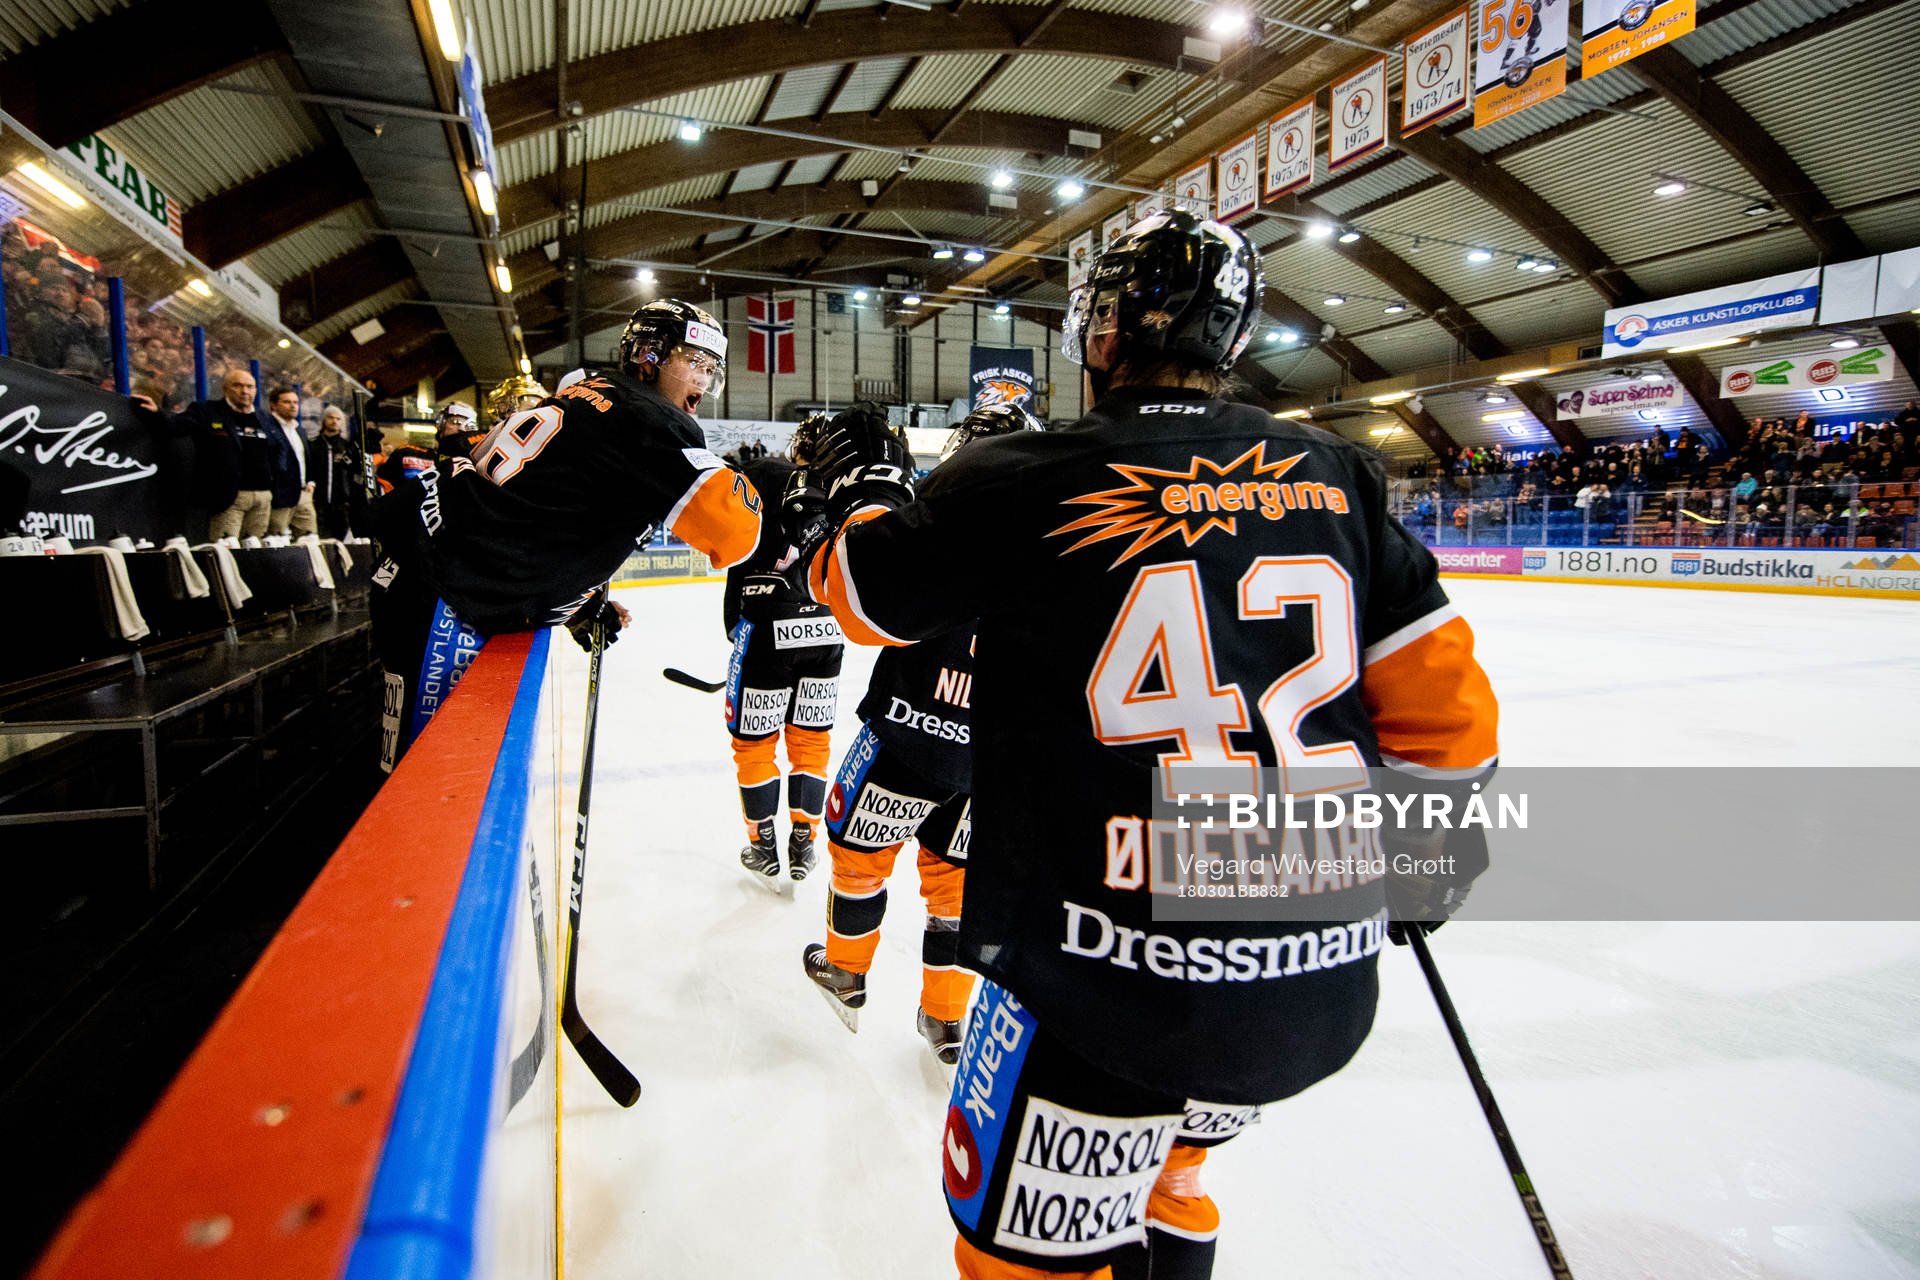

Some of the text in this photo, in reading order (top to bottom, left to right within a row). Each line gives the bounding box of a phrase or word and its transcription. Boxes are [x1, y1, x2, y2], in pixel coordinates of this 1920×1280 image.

[1408, 17, 1464, 57] Seriemester
[1480, 0, 1533, 53] 56
[1587, 10, 1689, 61] MORTEN JOHANSEN
[1409, 78, 1462, 119] 1973/74
[1344, 126, 1370, 151] 1975
[1213, 257, 1249, 304] 42
[1652, 314, 1690, 331] ASKER
[1692, 294, 1805, 324] KUNSTLØPKLUBB
[972, 367, 1035, 386] FRISK ASKER
[1138, 404, 1207, 415] CCM
[726, 430, 776, 447] energima
[1161, 479, 1350, 521] energima
[20, 511, 95, 540] ærum
[652, 554, 690, 569] TRELAST
[1558, 550, 1658, 574] 1881.no
[1672, 559, 1699, 572] 1881
[1702, 557, 1813, 579] Budstikka
[776, 621, 841, 641] NORSOL
[1086, 554, 1371, 802] 42
[744, 692, 787, 710] NORSOL
[743, 714, 784, 731] NORSOL
[861, 789, 929, 820] NORSOL
[851, 816, 914, 842] NORSOL
[1018, 1113, 1167, 1178] NORSOL
[1005, 1184, 1146, 1243] NORSOL
